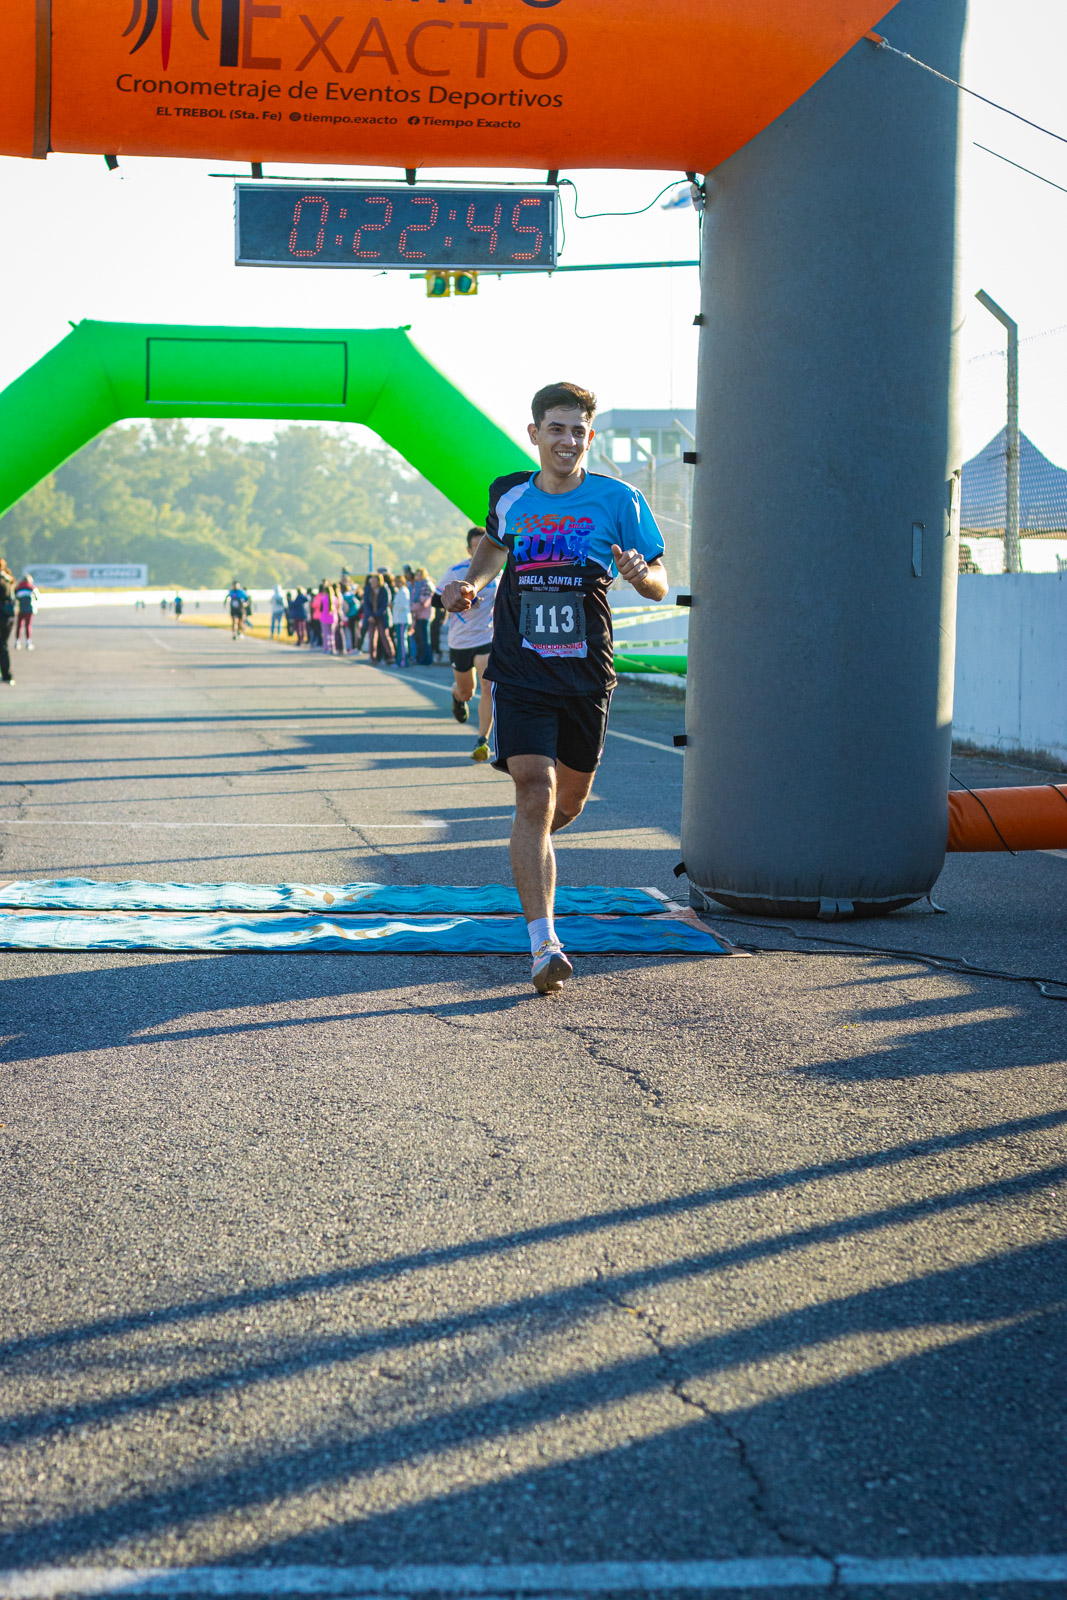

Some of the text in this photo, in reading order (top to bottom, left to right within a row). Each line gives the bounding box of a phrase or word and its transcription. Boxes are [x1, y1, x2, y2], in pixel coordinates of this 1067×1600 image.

[241, 0, 568, 80] EXACTO
[115, 73, 563, 109] Cronometraje de Eventos Deportivos
[156, 107, 282, 121] EL TREBOL (Sta. Fe)
[303, 113, 398, 125] tiempo.exacto
[422, 116, 521, 128] Tiempo Exacto
[289, 195, 543, 260] 0:22:45
[547, 575, 572, 586] SANTA
[573, 577, 583, 586] FE
[535, 604, 574, 633] 113
